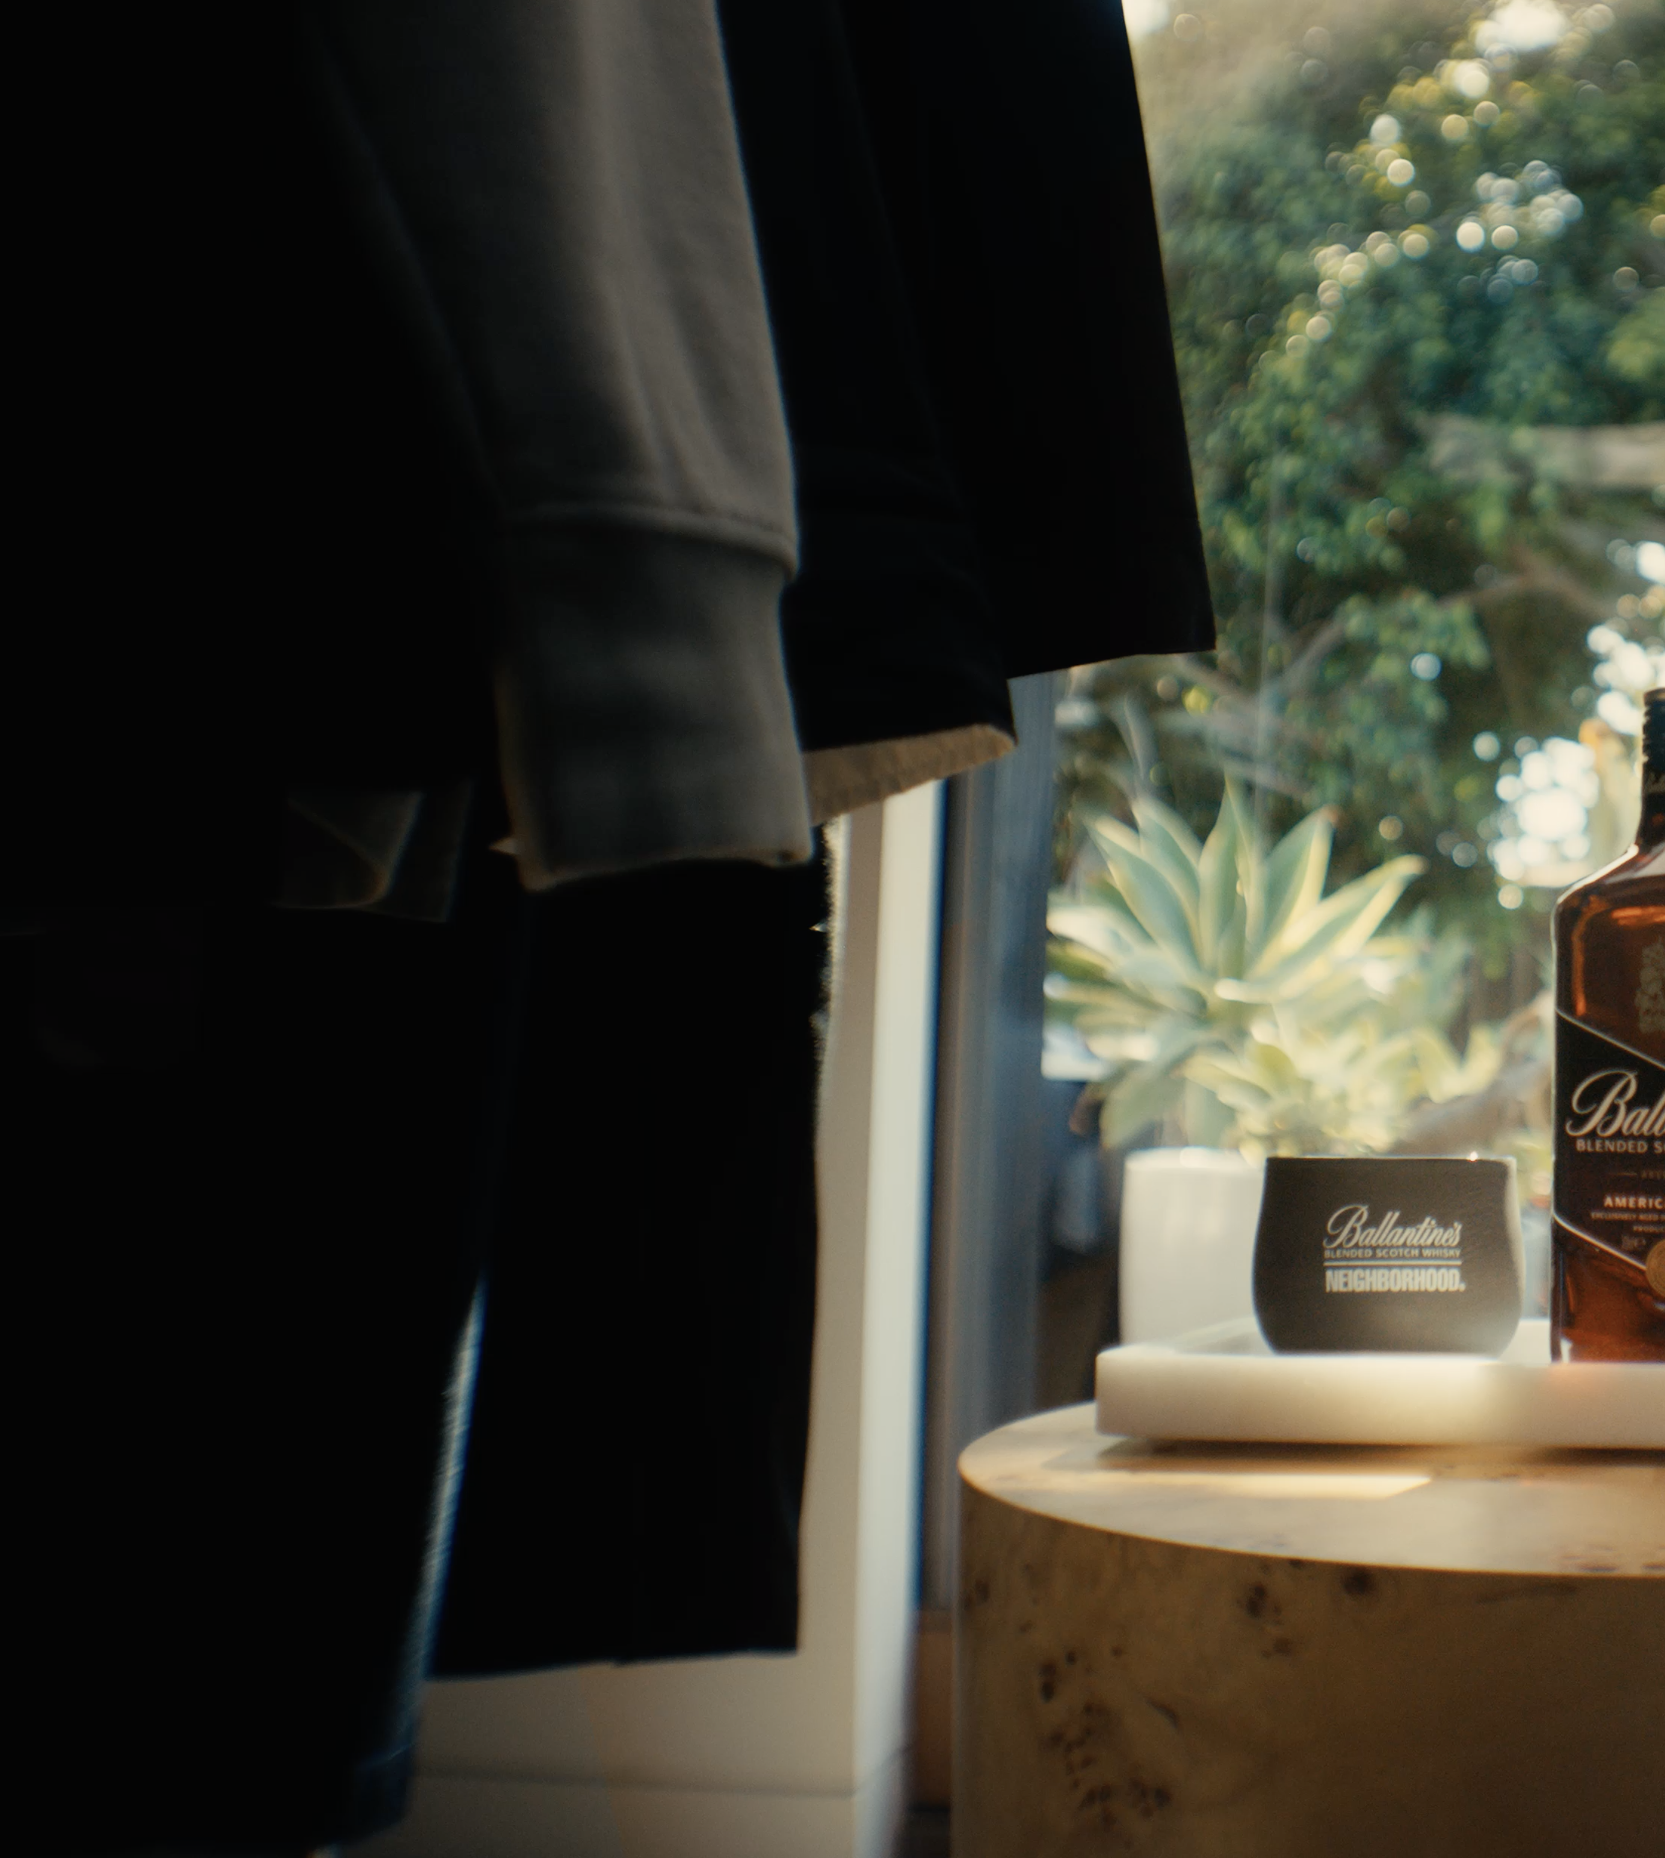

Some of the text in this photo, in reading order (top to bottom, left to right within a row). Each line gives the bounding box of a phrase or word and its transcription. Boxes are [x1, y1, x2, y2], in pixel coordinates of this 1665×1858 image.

[1575, 1139, 1648, 1154] BLENDED
[1323, 1204, 1463, 1249] Ballantine's
[1324, 1248, 1462, 1259] BLENDED SCOTCH WHISKY
